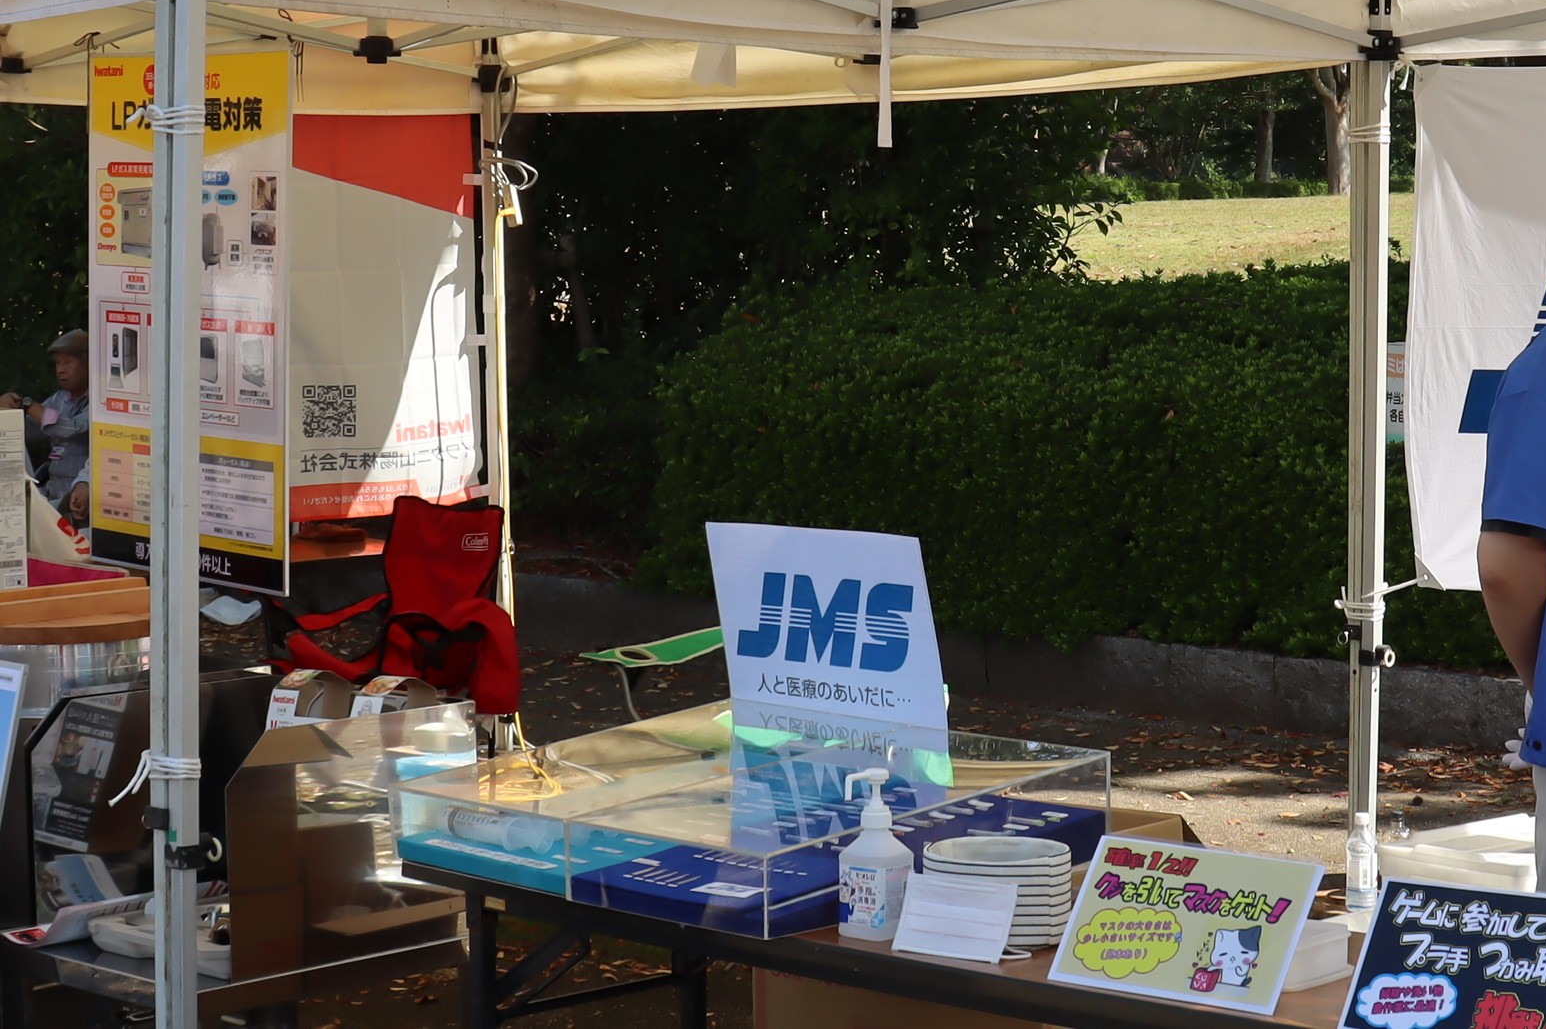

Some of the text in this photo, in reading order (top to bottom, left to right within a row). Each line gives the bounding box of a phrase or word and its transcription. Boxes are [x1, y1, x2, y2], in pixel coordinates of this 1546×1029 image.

[94, 65, 123, 77] Iwatani
[737, 572, 914, 672] JMS
[1400, 932, 1471, 973] プラ手
